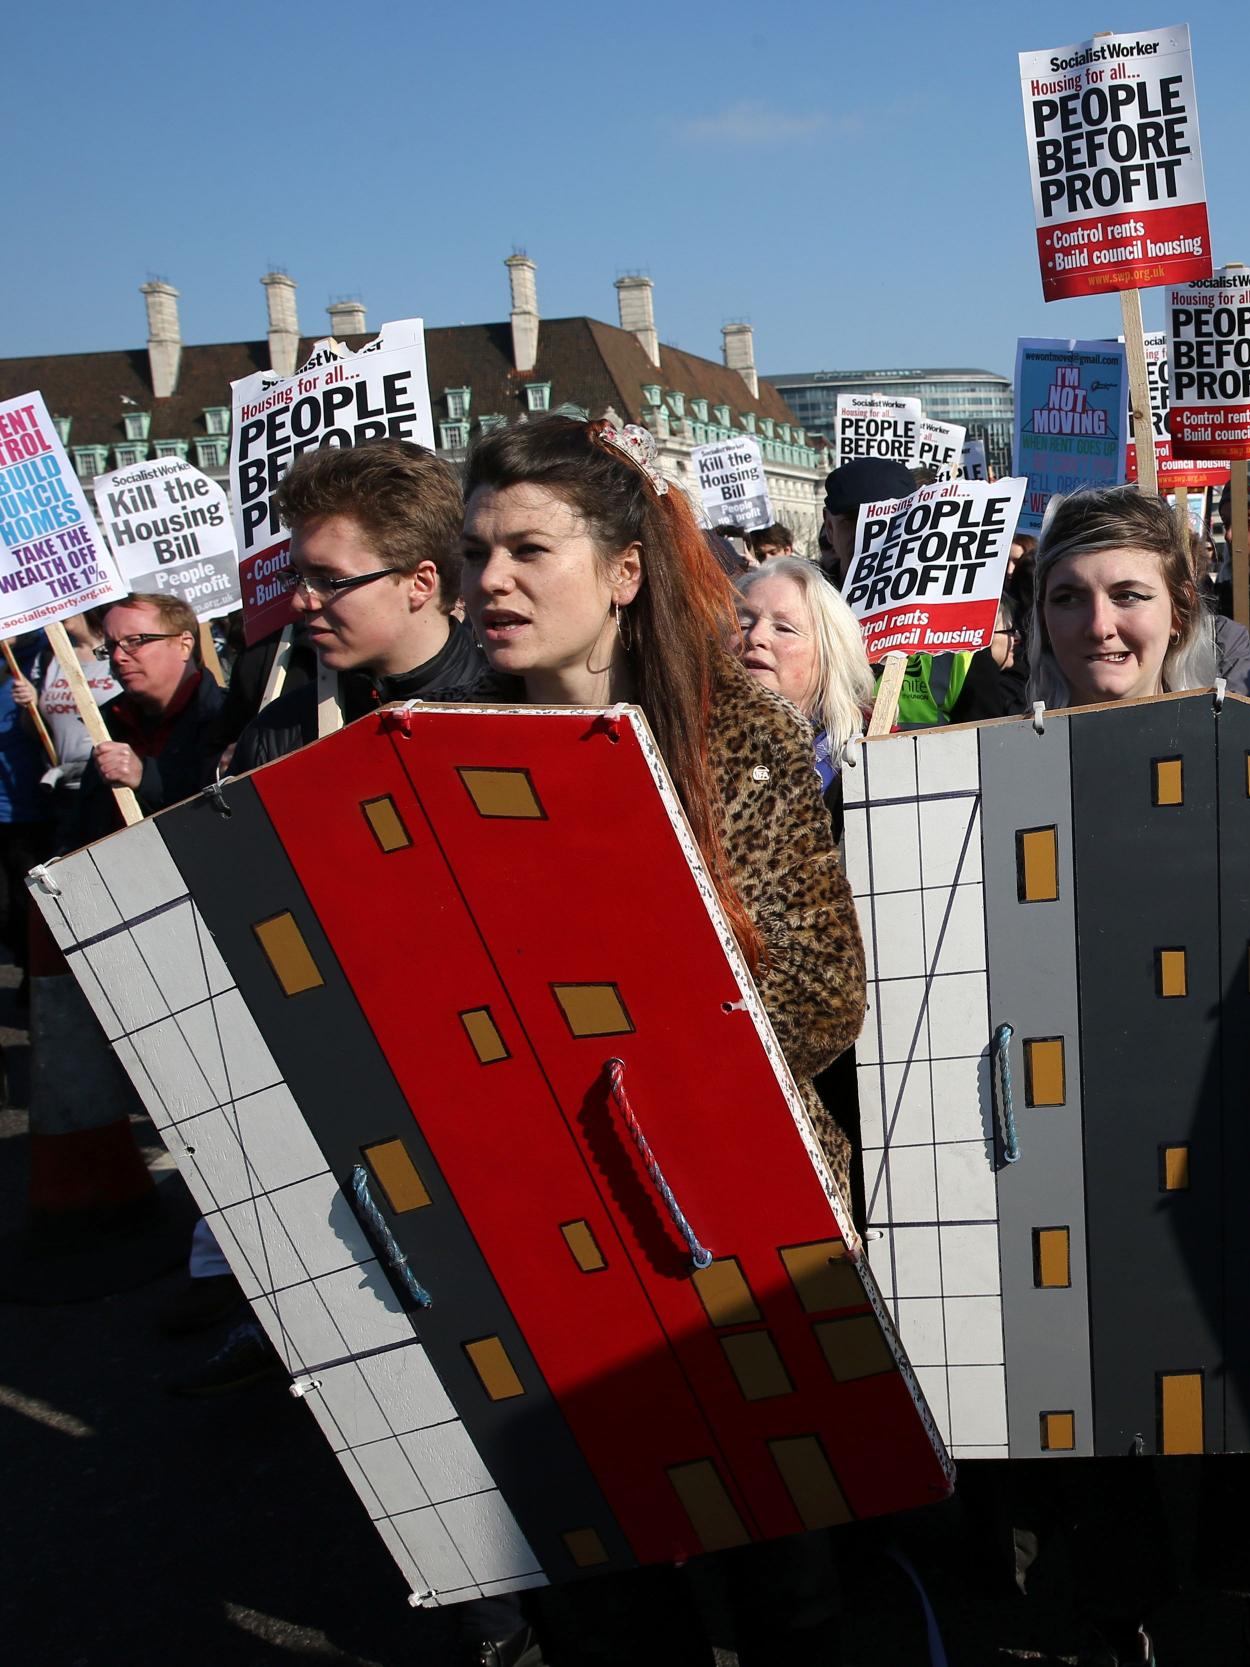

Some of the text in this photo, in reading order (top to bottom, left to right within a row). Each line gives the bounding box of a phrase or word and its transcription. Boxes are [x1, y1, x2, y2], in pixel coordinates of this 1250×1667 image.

[1031, 62, 1140, 96] Housing for all...
[1033, 75, 1186, 138] PEOPLE
[1036, 116, 1191, 178] BEFORE
[1040, 158, 1182, 218] PROFIT
[1053, 219, 1145, 249] Control rents
[1055, 235, 1202, 271] Build council housing
[1088, 265, 1165, 286] www.swp.org.uk
[1171, 291, 1215, 308] Housing
[1218, 292, 1235, 305] for
[1057, 367, 1079, 386] I'M
[241, 365, 360, 423] Housing for all...
[1049, 386, 1087, 413] NOT
[0, 405, 38, 439] ENT
[239, 371, 415, 463] PEOPLE
[841, 408, 868, 418] Housing
[869, 409, 880, 417] for
[841, 418, 915, 438] PEOPLE
[1034, 409, 1106, 434] MOVING
[1183, 410, 1224, 425] Control
[0, 429, 51, 467] TROL
[840, 437, 915, 458] BEFORE
[1183, 427, 1212, 442] Build
[699, 452, 752, 473] Kill the
[699, 467, 759, 489] Housing
[0, 478, 72, 520] UNCIL
[107, 477, 210, 518] Kill the
[721, 483, 746, 501] Bill
[867, 485, 970, 518] Housing for all...
[0, 500, 81, 546] HOMES
[721, 501, 753, 515] People
[736, 507, 761, 523] profit
[111, 501, 224, 547] Housing
[861, 497, 1011, 555] PEOPLE
[12, 526, 91, 566] TAKE THE
[153, 532, 200, 565] Bill
[851, 527, 1003, 585] BEFORE
[0, 544, 96, 594] WEALTH OFF
[46, 563, 107, 597] THE 1%
[155, 563, 215, 588] People
[184, 573, 231, 602] profit
[846, 562, 986, 611] PROFIT
[890, 610, 929, 626] rents
[870, 626, 985, 652] council housing
[901, 679, 928, 693] nite
